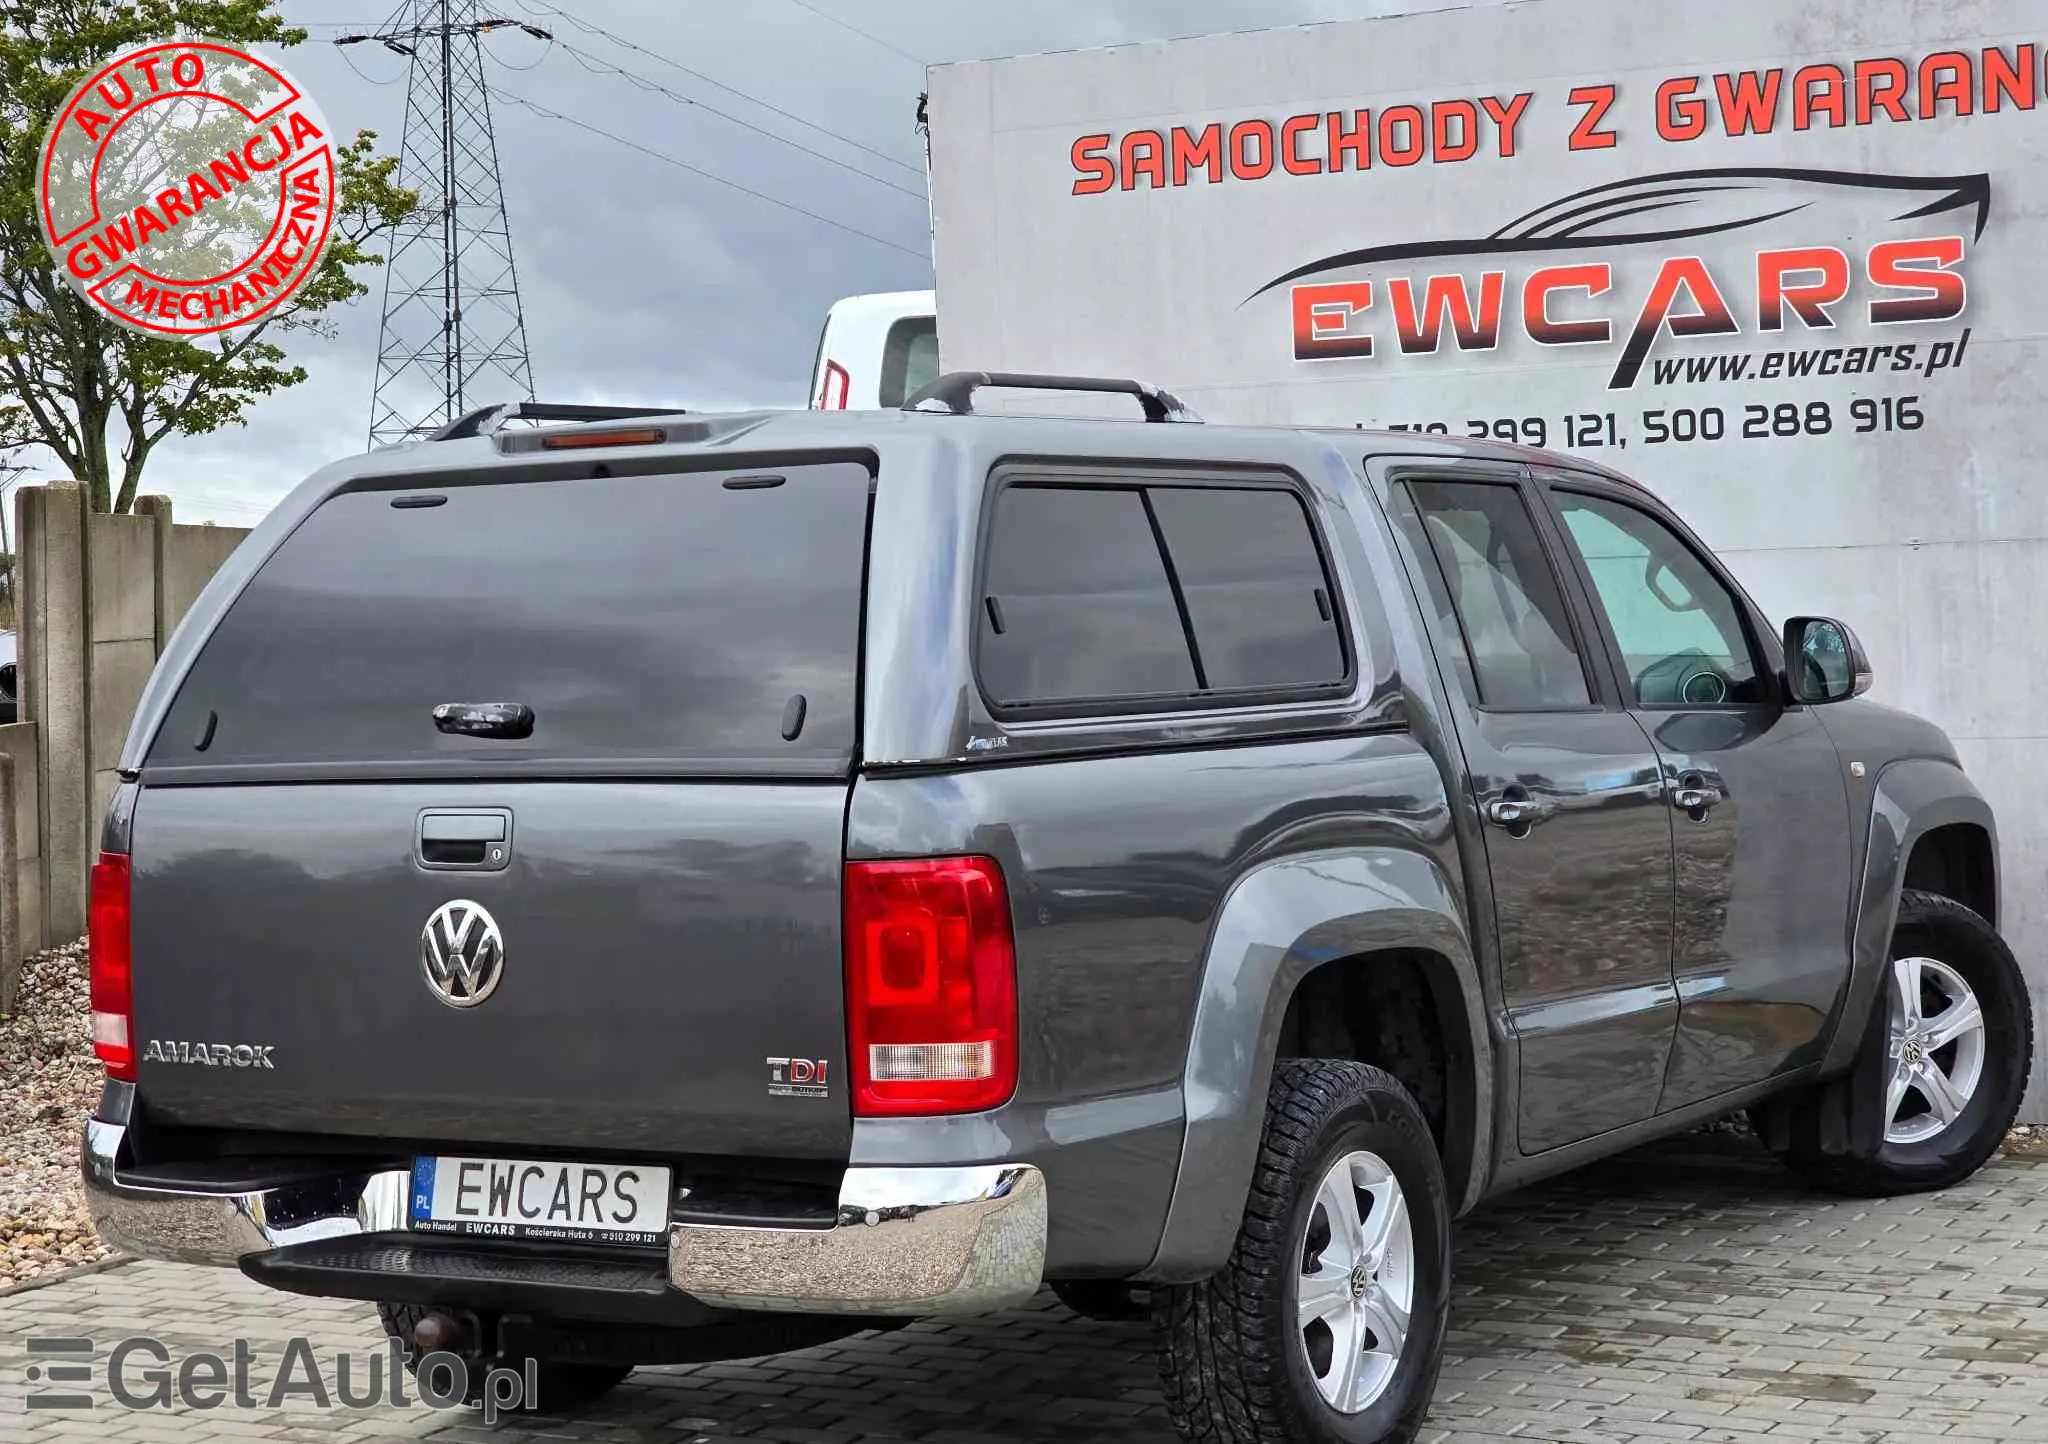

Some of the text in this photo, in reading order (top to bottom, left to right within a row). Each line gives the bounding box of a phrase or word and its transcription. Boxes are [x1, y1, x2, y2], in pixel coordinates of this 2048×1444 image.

[1071, 42, 2048, 197] SAMOCHODY Z GWARAN
[1290, 236, 1966, 390] EWCARS
[1653, 328, 1972, 385] www.ewcars.pl
[1563, 413, 1627, 450] 121,
[1643, 407, 1724, 444] 500
[1742, 401, 1832, 439] 288
[1850, 395, 1924, 433] 916
[142, 1039, 275, 1069] AMAROK
[766, 1057, 828, 1084] TDI
[416, 1194, 430, 1210] PL
[455, 1161, 640, 1224] EWCARS
[414, 1220, 431, 1230] Auto
[432, 1222, 457, 1232] Handel
[465, 1222, 516, 1236] EWCARS
[568, 1229, 586, 1240] Huta
[625, 1232, 641, 1243] 299
[643, 1233, 656, 1243] 121
